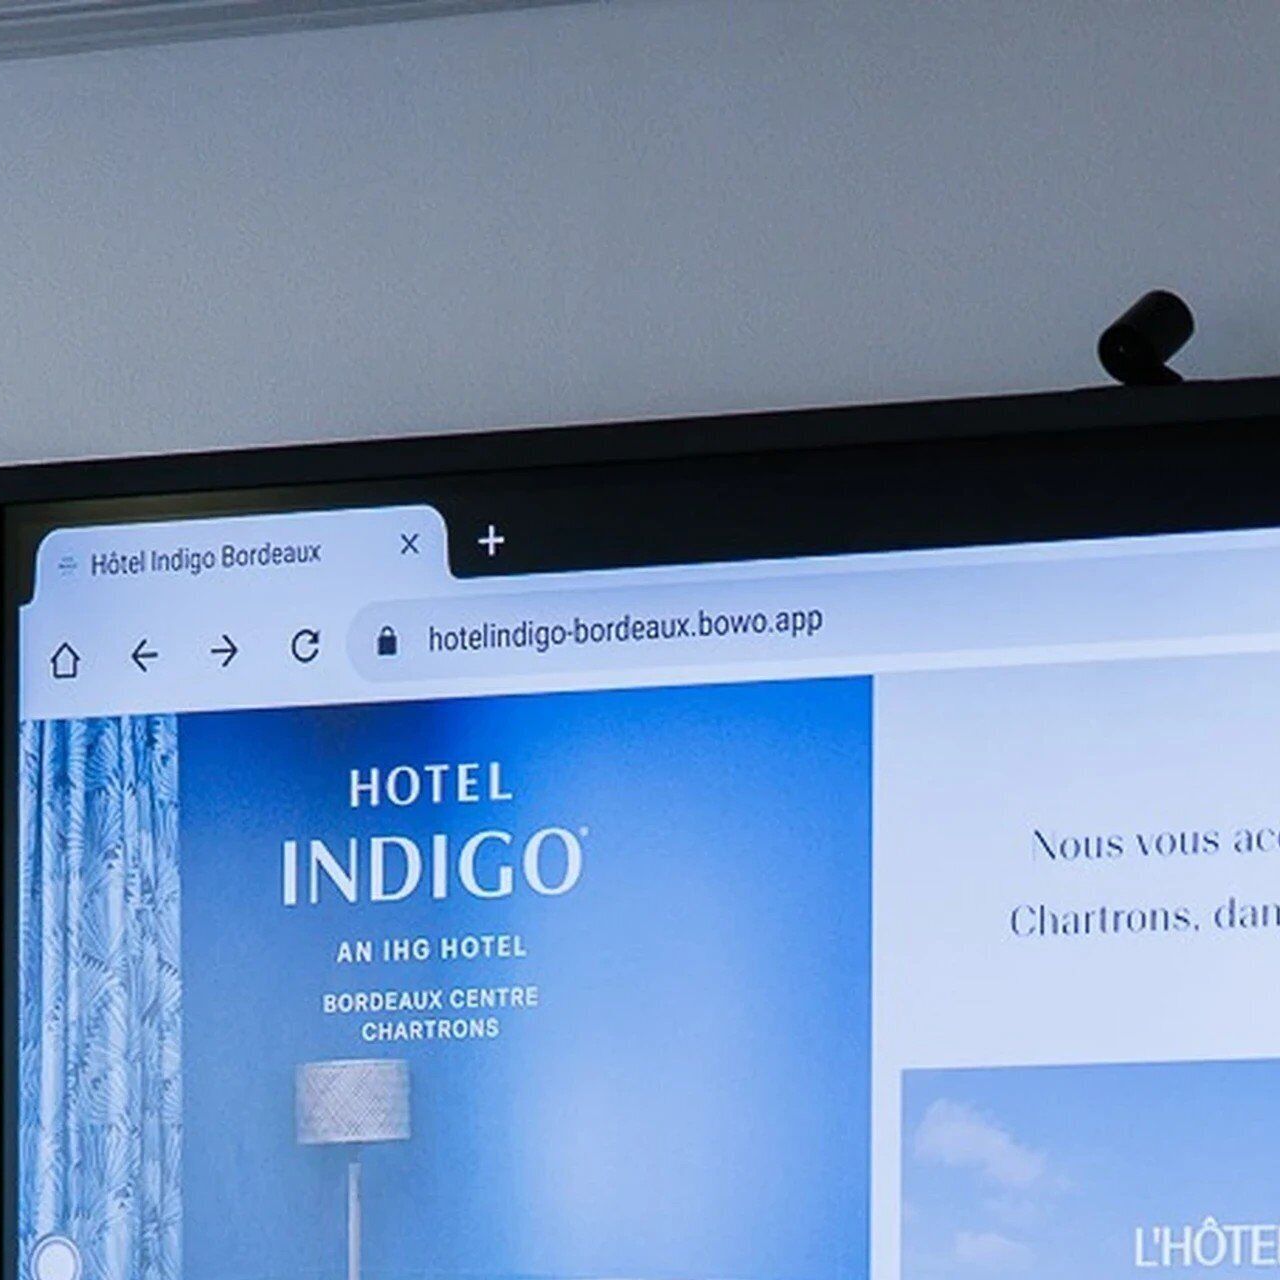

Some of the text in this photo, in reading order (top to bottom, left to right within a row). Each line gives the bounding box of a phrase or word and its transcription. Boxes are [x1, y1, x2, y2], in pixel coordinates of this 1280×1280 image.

[91, 543, 322, 575] Hôtel Indigo Bordeaux
[428, 608, 824, 653] hotelindigo-bordeaux.bowo.app
[350, 761, 513, 808] HOTEL
[1031, 828, 1123, 862] Nous
[1135, 829, 1220, 857] vous
[336, 935, 528, 964] AN IHG HOTEL
[323, 986, 540, 1014] BORDEAUX CENTRE
[361, 1017, 500, 1042] CHARTRONS
